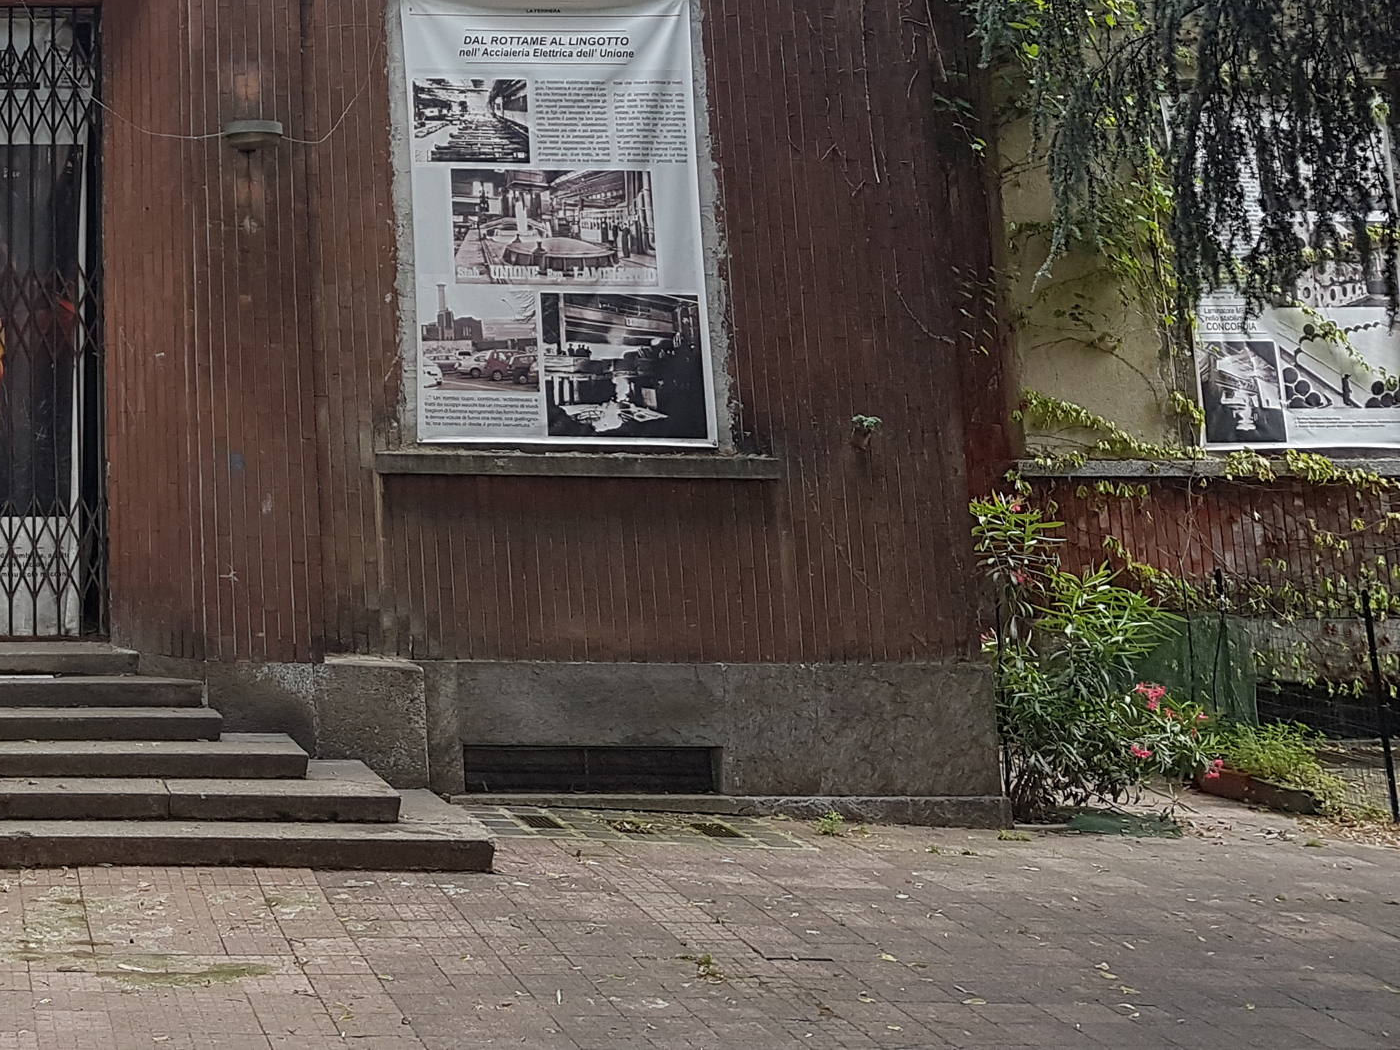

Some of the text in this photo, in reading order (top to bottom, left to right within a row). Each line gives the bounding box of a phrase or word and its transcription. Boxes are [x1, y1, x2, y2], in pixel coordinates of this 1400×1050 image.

[463, 35, 629, 46] DAL ROTTAME AL LINGOTTO
[459, 48, 635, 59] nell' Acciaieria Elettrica dell' Unione
[490, 265, 540, 279] UNIONE
